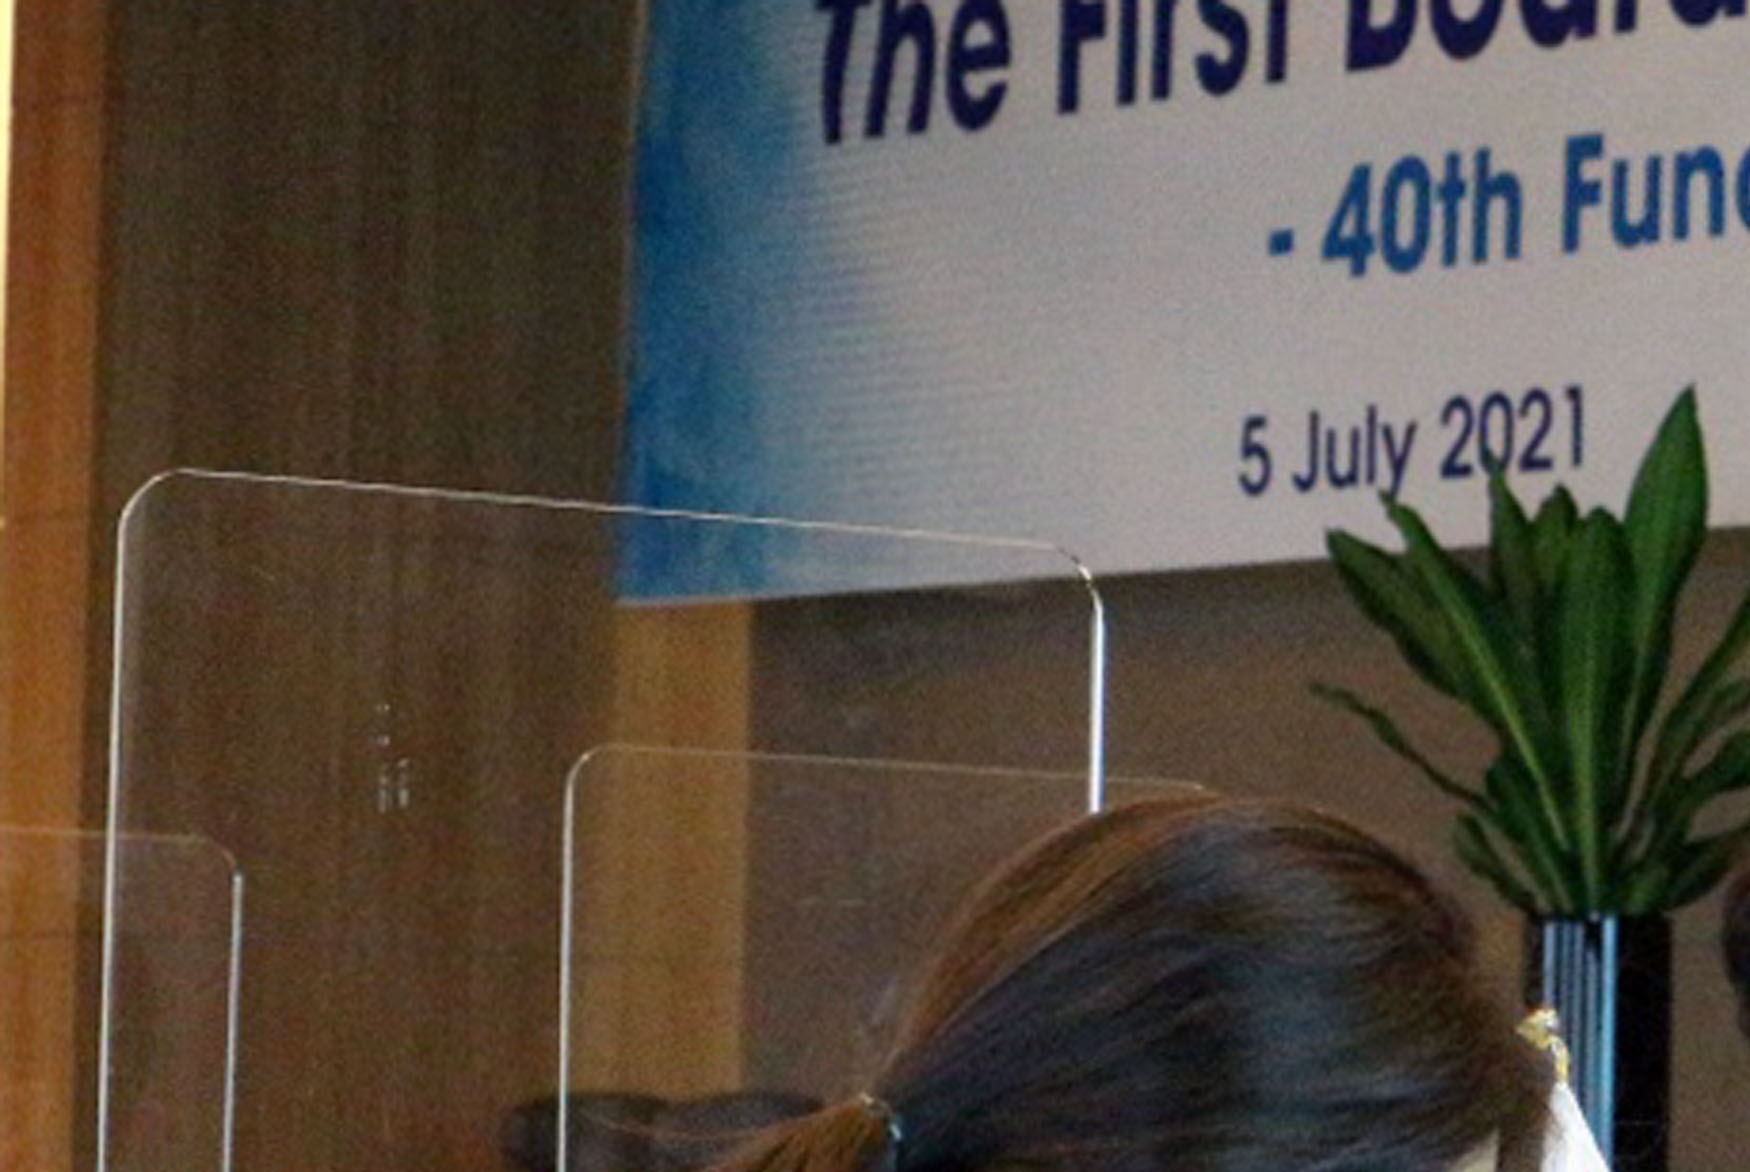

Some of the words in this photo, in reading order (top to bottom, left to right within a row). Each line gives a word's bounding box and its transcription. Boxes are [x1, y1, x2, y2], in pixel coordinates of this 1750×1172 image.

[814, 0, 1012, 146] The
[1320, 146, 1524, 279] 40th
[1238, 414, 1272, 497] 5
[1292, 404, 1418, 501] July
[1440, 384, 1583, 479] 2021
